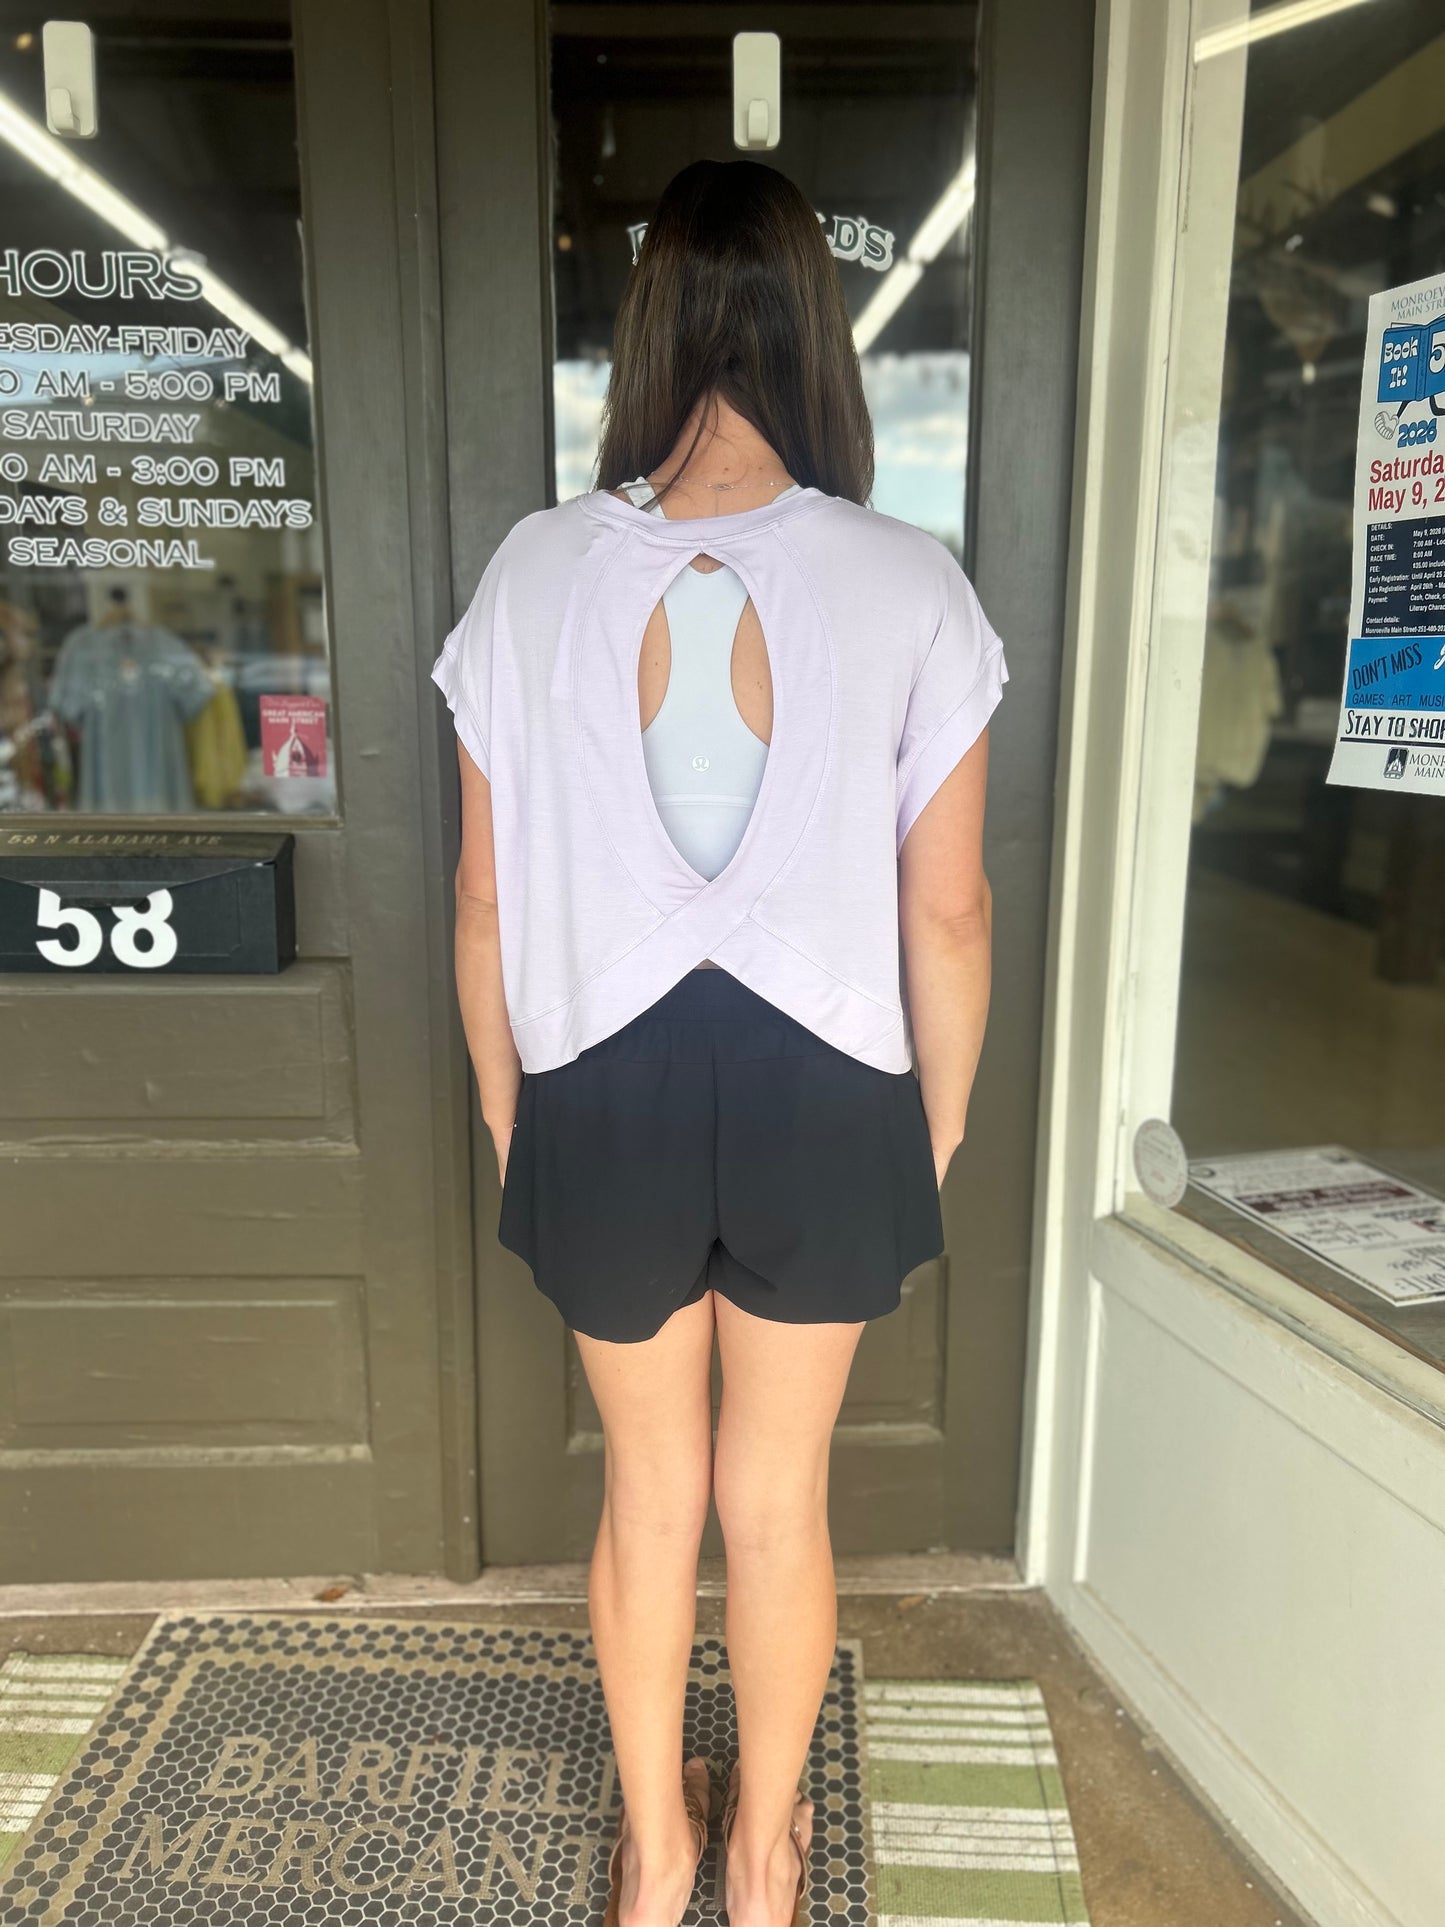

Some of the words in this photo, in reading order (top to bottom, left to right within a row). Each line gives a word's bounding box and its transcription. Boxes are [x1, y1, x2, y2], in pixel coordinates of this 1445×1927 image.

[1397, 304, 1422, 321] MAIN
[1383, 336, 1418, 364] Book
[1389, 364, 1408, 389] It!
[34, 369, 91, 397] AM
[100, 380, 115, 391] -
[125, 371, 214, 401] 5:00
[224, 372, 281, 402] PM
[3, 409, 200, 443] SATURDAY
[1397, 418, 1437, 448] 2026
[39, 454, 97, 484] AM
[107, 467, 121, 477] -
[132, 456, 219, 486] 3:00
[230, 457, 286, 487] PM
[1370, 450, 1444, 483] Saturda
[1368, 487, 1406, 514] May
[1412, 481, 1427, 510] 9,
[99, 496, 127, 526] &
[138, 497, 313, 528] SUNDAYS
[1370, 523, 1393, 531] DETAILS:
[1412, 530, 1423, 538] May
[1429, 527, 1442, 536] 2026
[1370, 534, 1385, 542] DATE:
[1424, 539, 1433, 547] AM
[9, 536, 216, 569] SEASONAL
[1370, 544, 1387, 552] CHECK
[1424, 550, 1433, 558] AM
[1369, 576, 1380, 584] Early
[1381, 574, 1410, 584] Registration:
[1423, 571, 1435, 580] April
[1368, 586, 1378, 594] Late
[1379, 585, 1408, 594] Registration:
[1410, 583, 1422, 591] April
[1409, 605, 1427, 613] Literary
[1365, 626, 1390, 634] Monroeville
[1352, 655, 1388, 691] DON'T
[1390, 643, 1423, 675] MISS
[1352, 693, 1385, 706] GAMES
[1392, 694, 1412, 706] ART
[262, 709, 286, 717] GREAT
[288, 710, 326, 718] AMERICAN
[1388, 717, 1405, 737] TO
[1415, 767, 1445, 778] MAIN
[7, 835, 38, 844] 58
[44, 835, 61, 844] N
[67, 835, 168, 845] ALABAMA
[177, 835, 223, 845] AVE
[36, 888, 178, 968] 58
